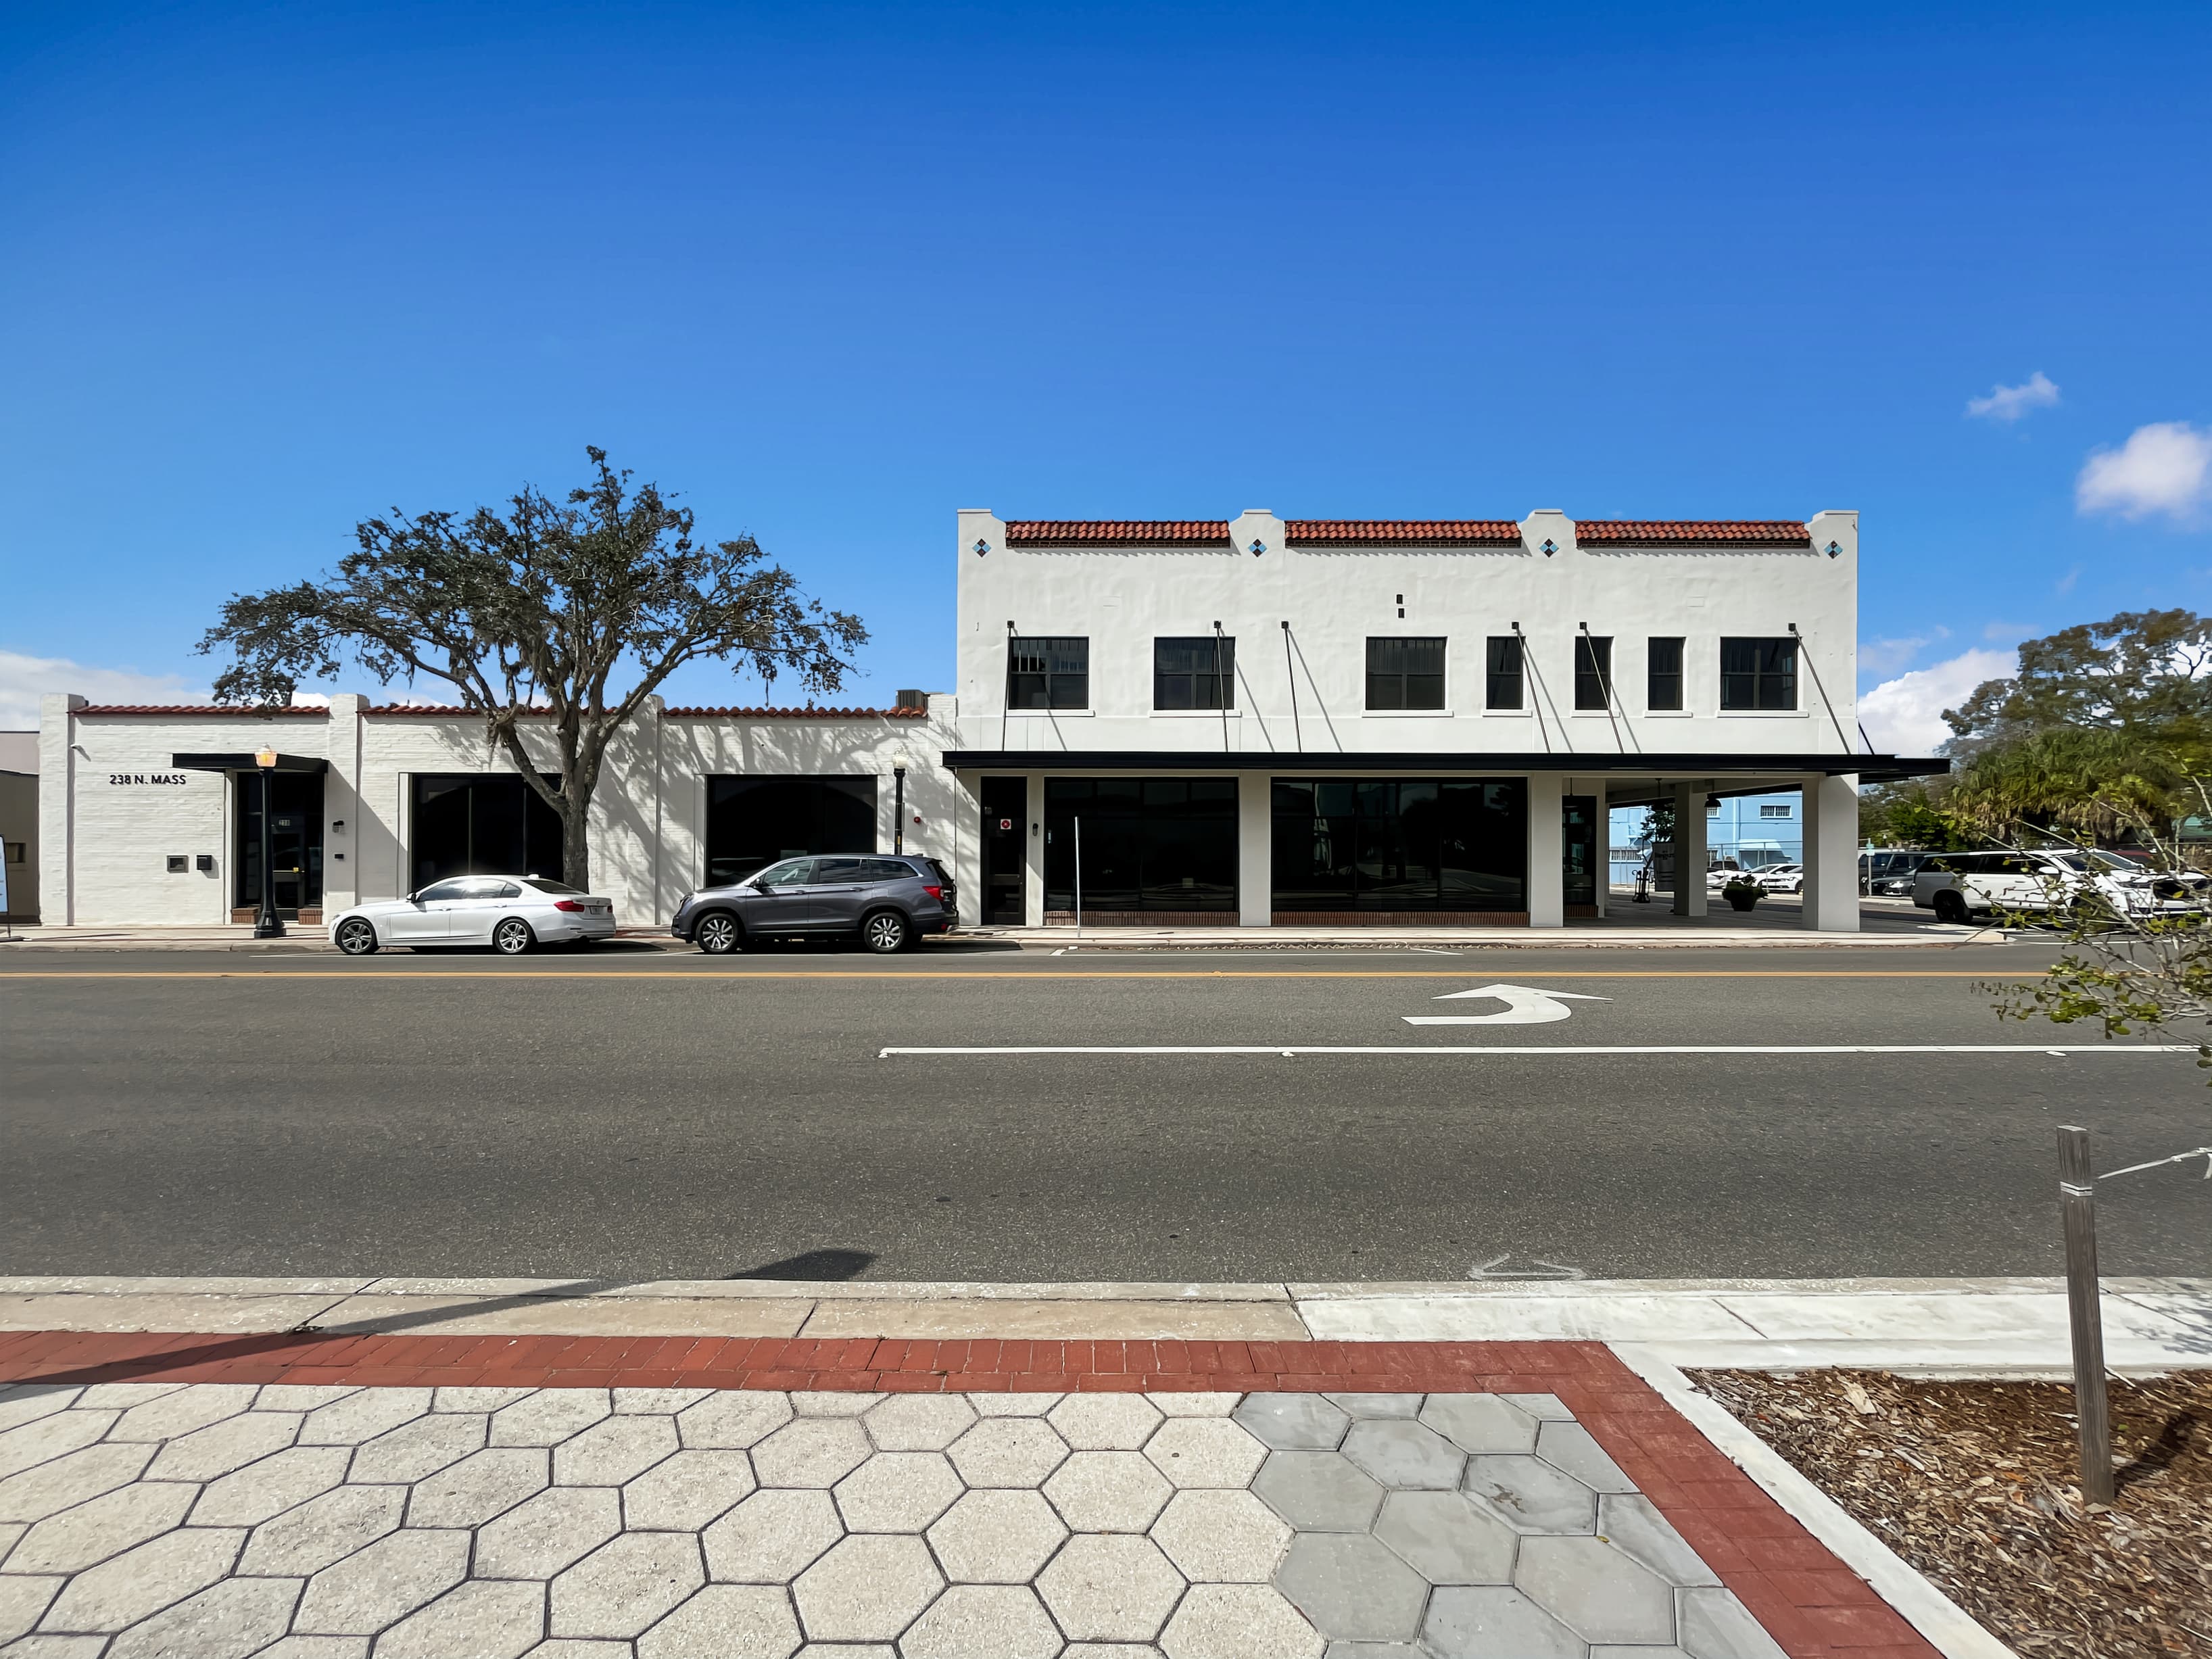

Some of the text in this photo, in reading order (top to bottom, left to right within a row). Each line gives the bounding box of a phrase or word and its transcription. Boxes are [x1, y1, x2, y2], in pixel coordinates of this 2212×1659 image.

[109, 774, 187, 785] 238 N. MASS
